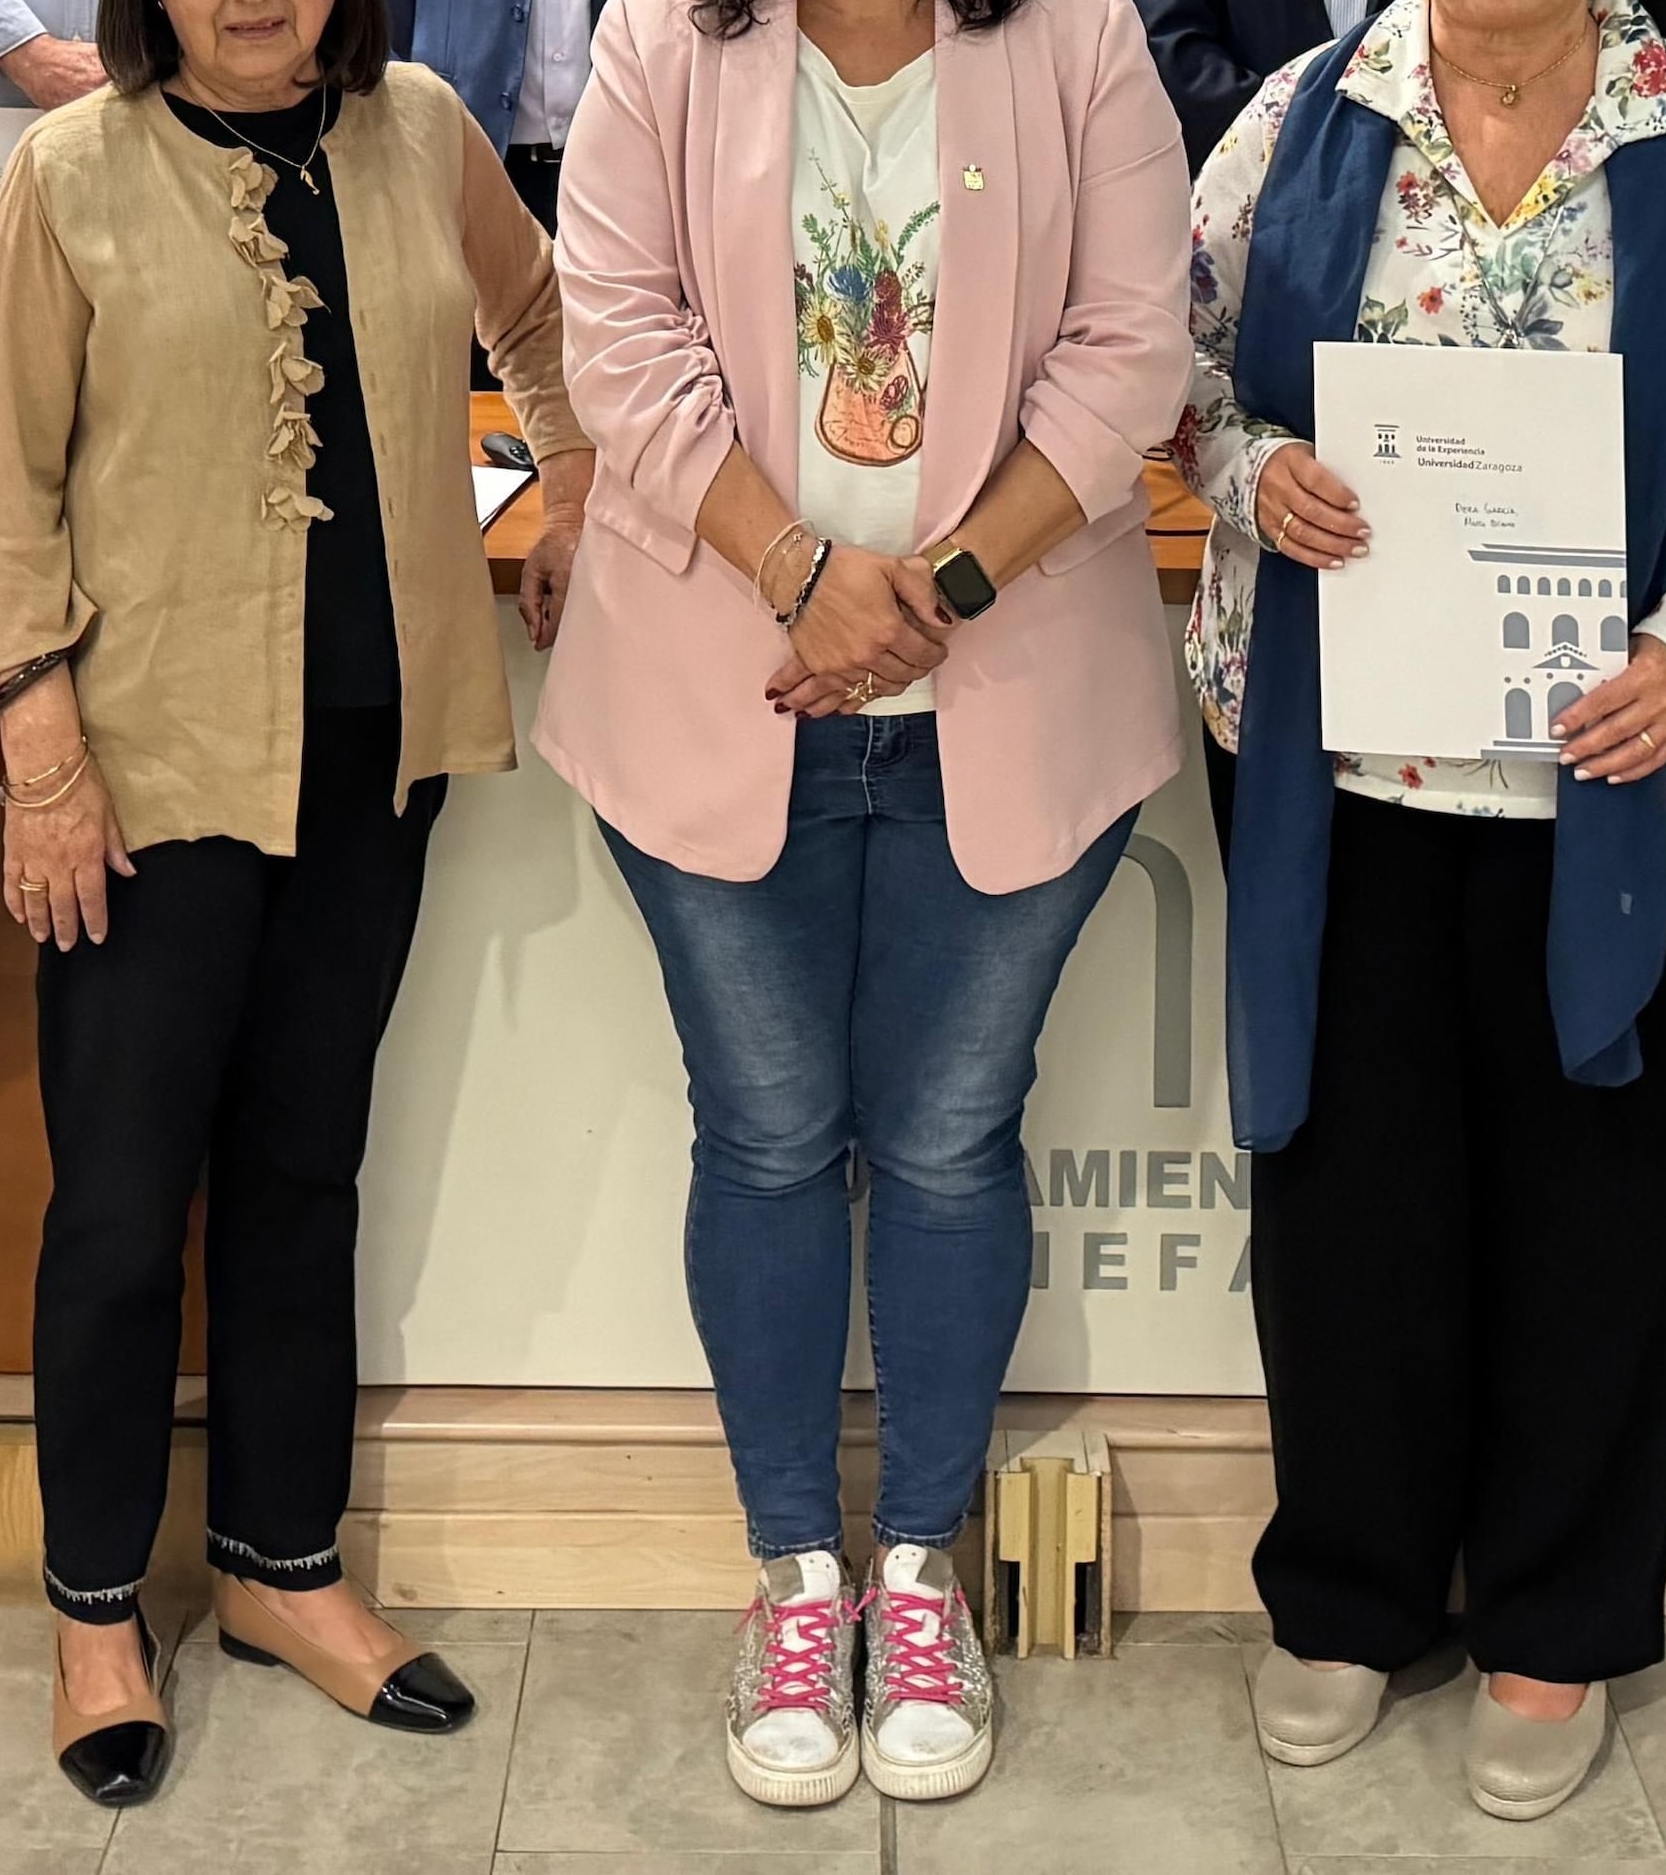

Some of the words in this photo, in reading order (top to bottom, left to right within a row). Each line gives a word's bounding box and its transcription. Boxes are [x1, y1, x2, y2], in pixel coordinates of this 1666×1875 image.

[1416, 435, 1466, 446] Universidad
[1416, 445, 1427, 453] de
[1437, 446, 1485, 456] Experiencia
